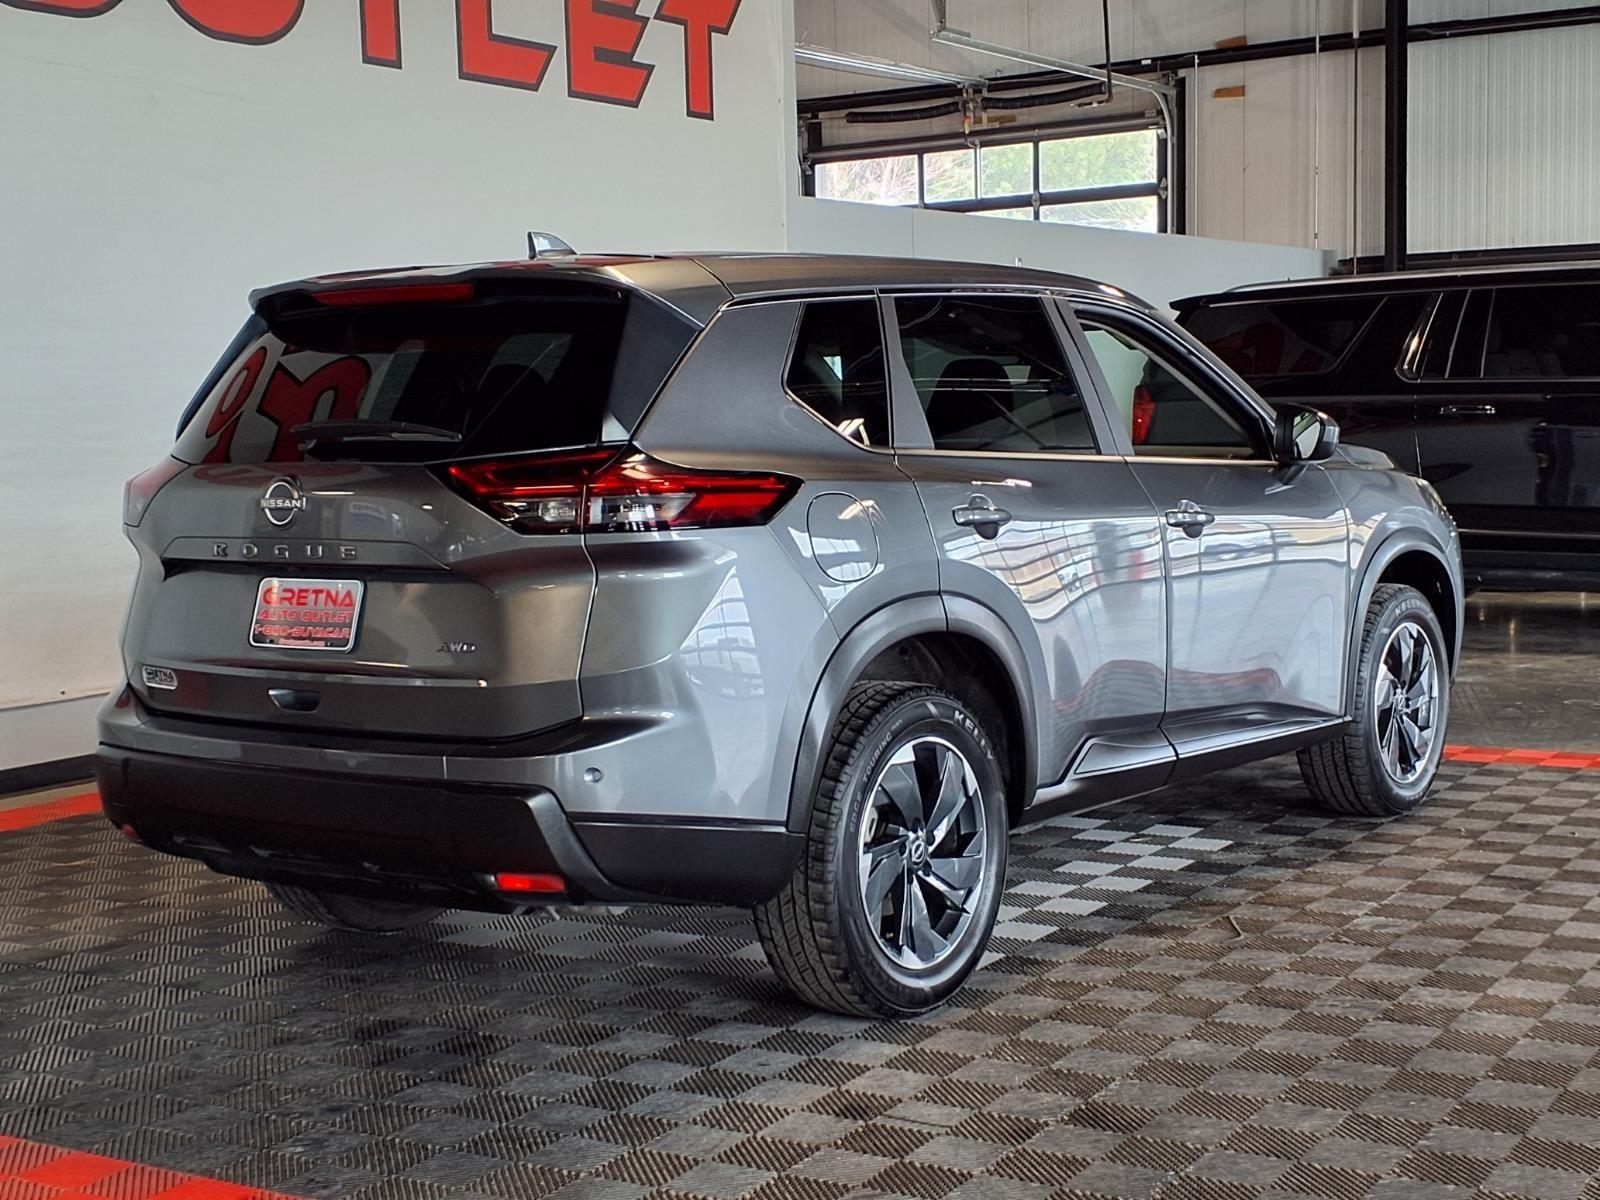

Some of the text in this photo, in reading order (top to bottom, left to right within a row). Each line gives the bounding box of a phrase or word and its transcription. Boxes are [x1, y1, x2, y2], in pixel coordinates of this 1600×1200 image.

[0, 0, 743, 121] LET
[260, 497, 304, 511] NISSAN
[213, 544, 358, 559] ROGUE
[262, 587, 355, 607] GRETNA
[257, 609, 353, 623] AUTO OUTLET
[1395, 599, 1419, 616] KELLY
[437, 642, 477, 653] AWD
[954, 710, 993, 760] KELLY
[862, 732, 892, 783] TOURING
